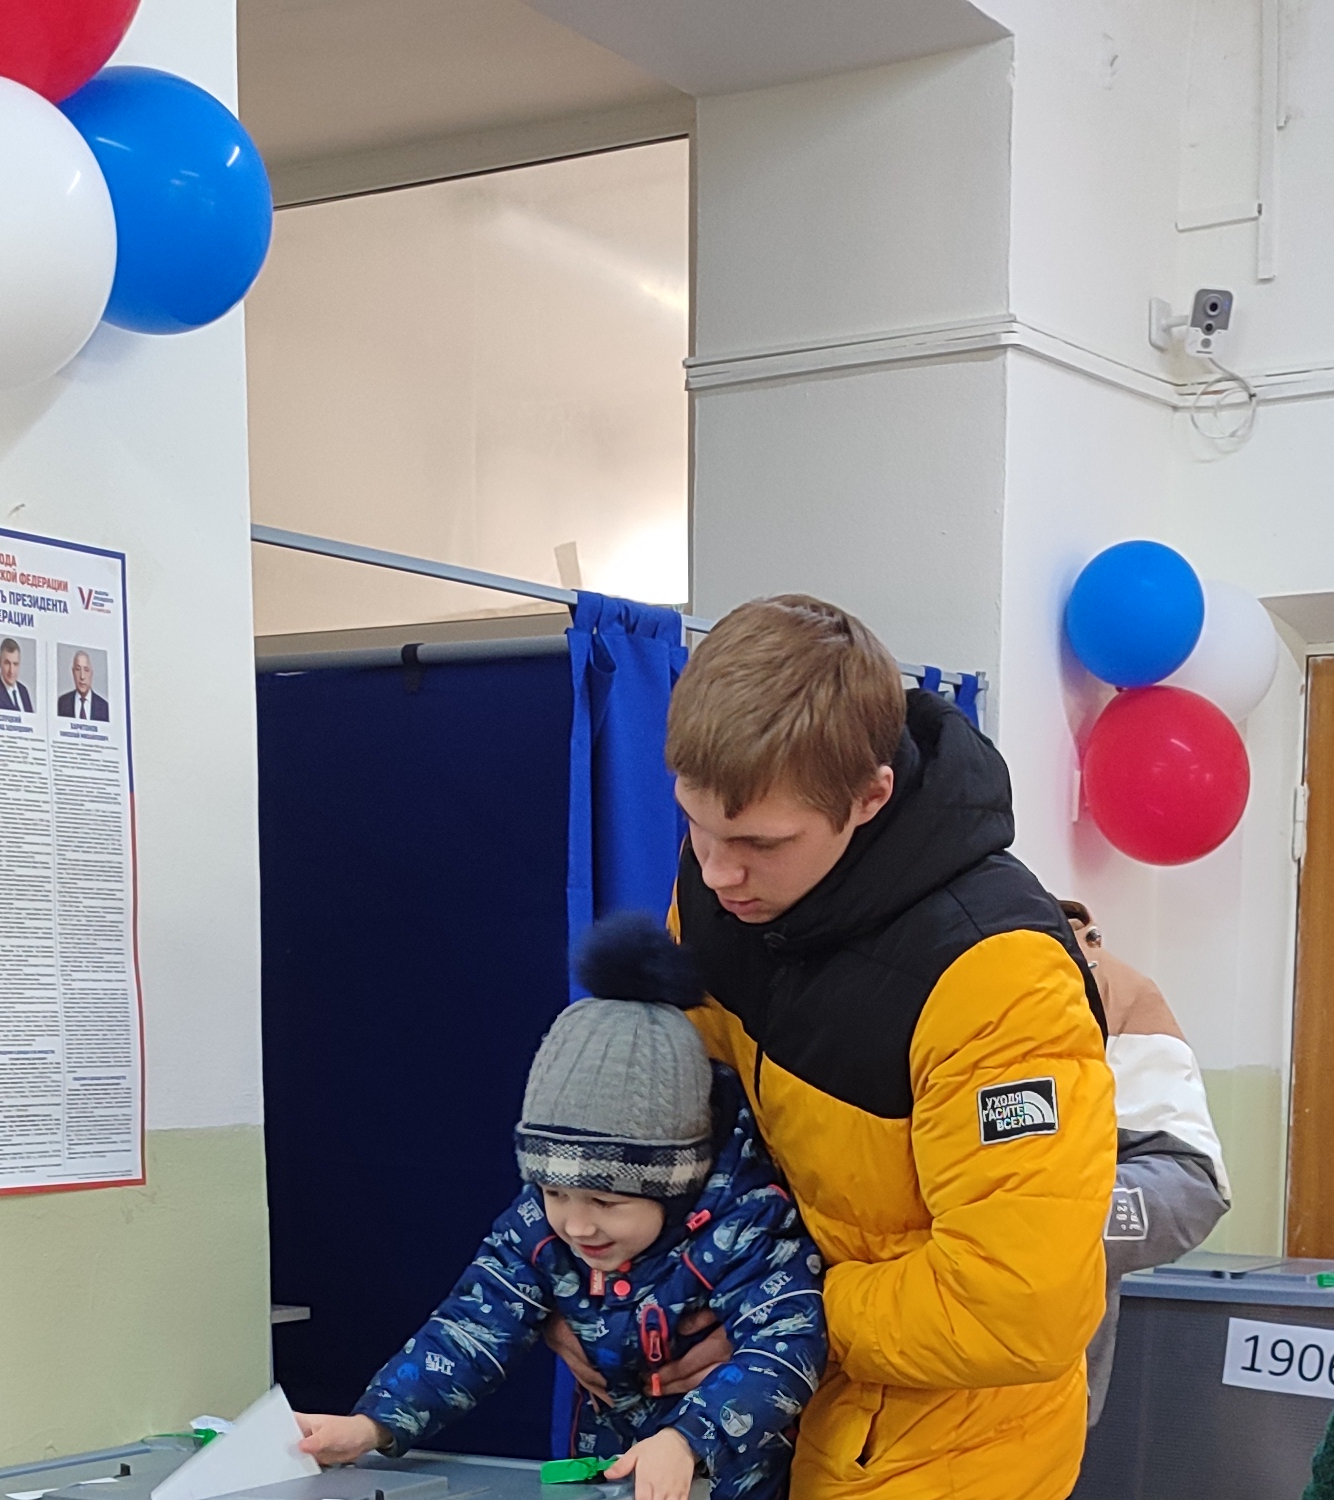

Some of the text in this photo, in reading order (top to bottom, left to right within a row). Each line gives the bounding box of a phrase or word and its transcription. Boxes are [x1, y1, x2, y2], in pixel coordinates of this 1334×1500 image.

[19, 572, 69, 593] ФЕДЕРАЦИИ
[8, 591, 69, 614] ПРЕЗИДЕНТА
[986, 1092, 1022, 1110] УХОДЯ
[983, 1104, 1024, 1122] ГАСИТЕ
[996, 1115, 1026, 1131] ВСЕХ
